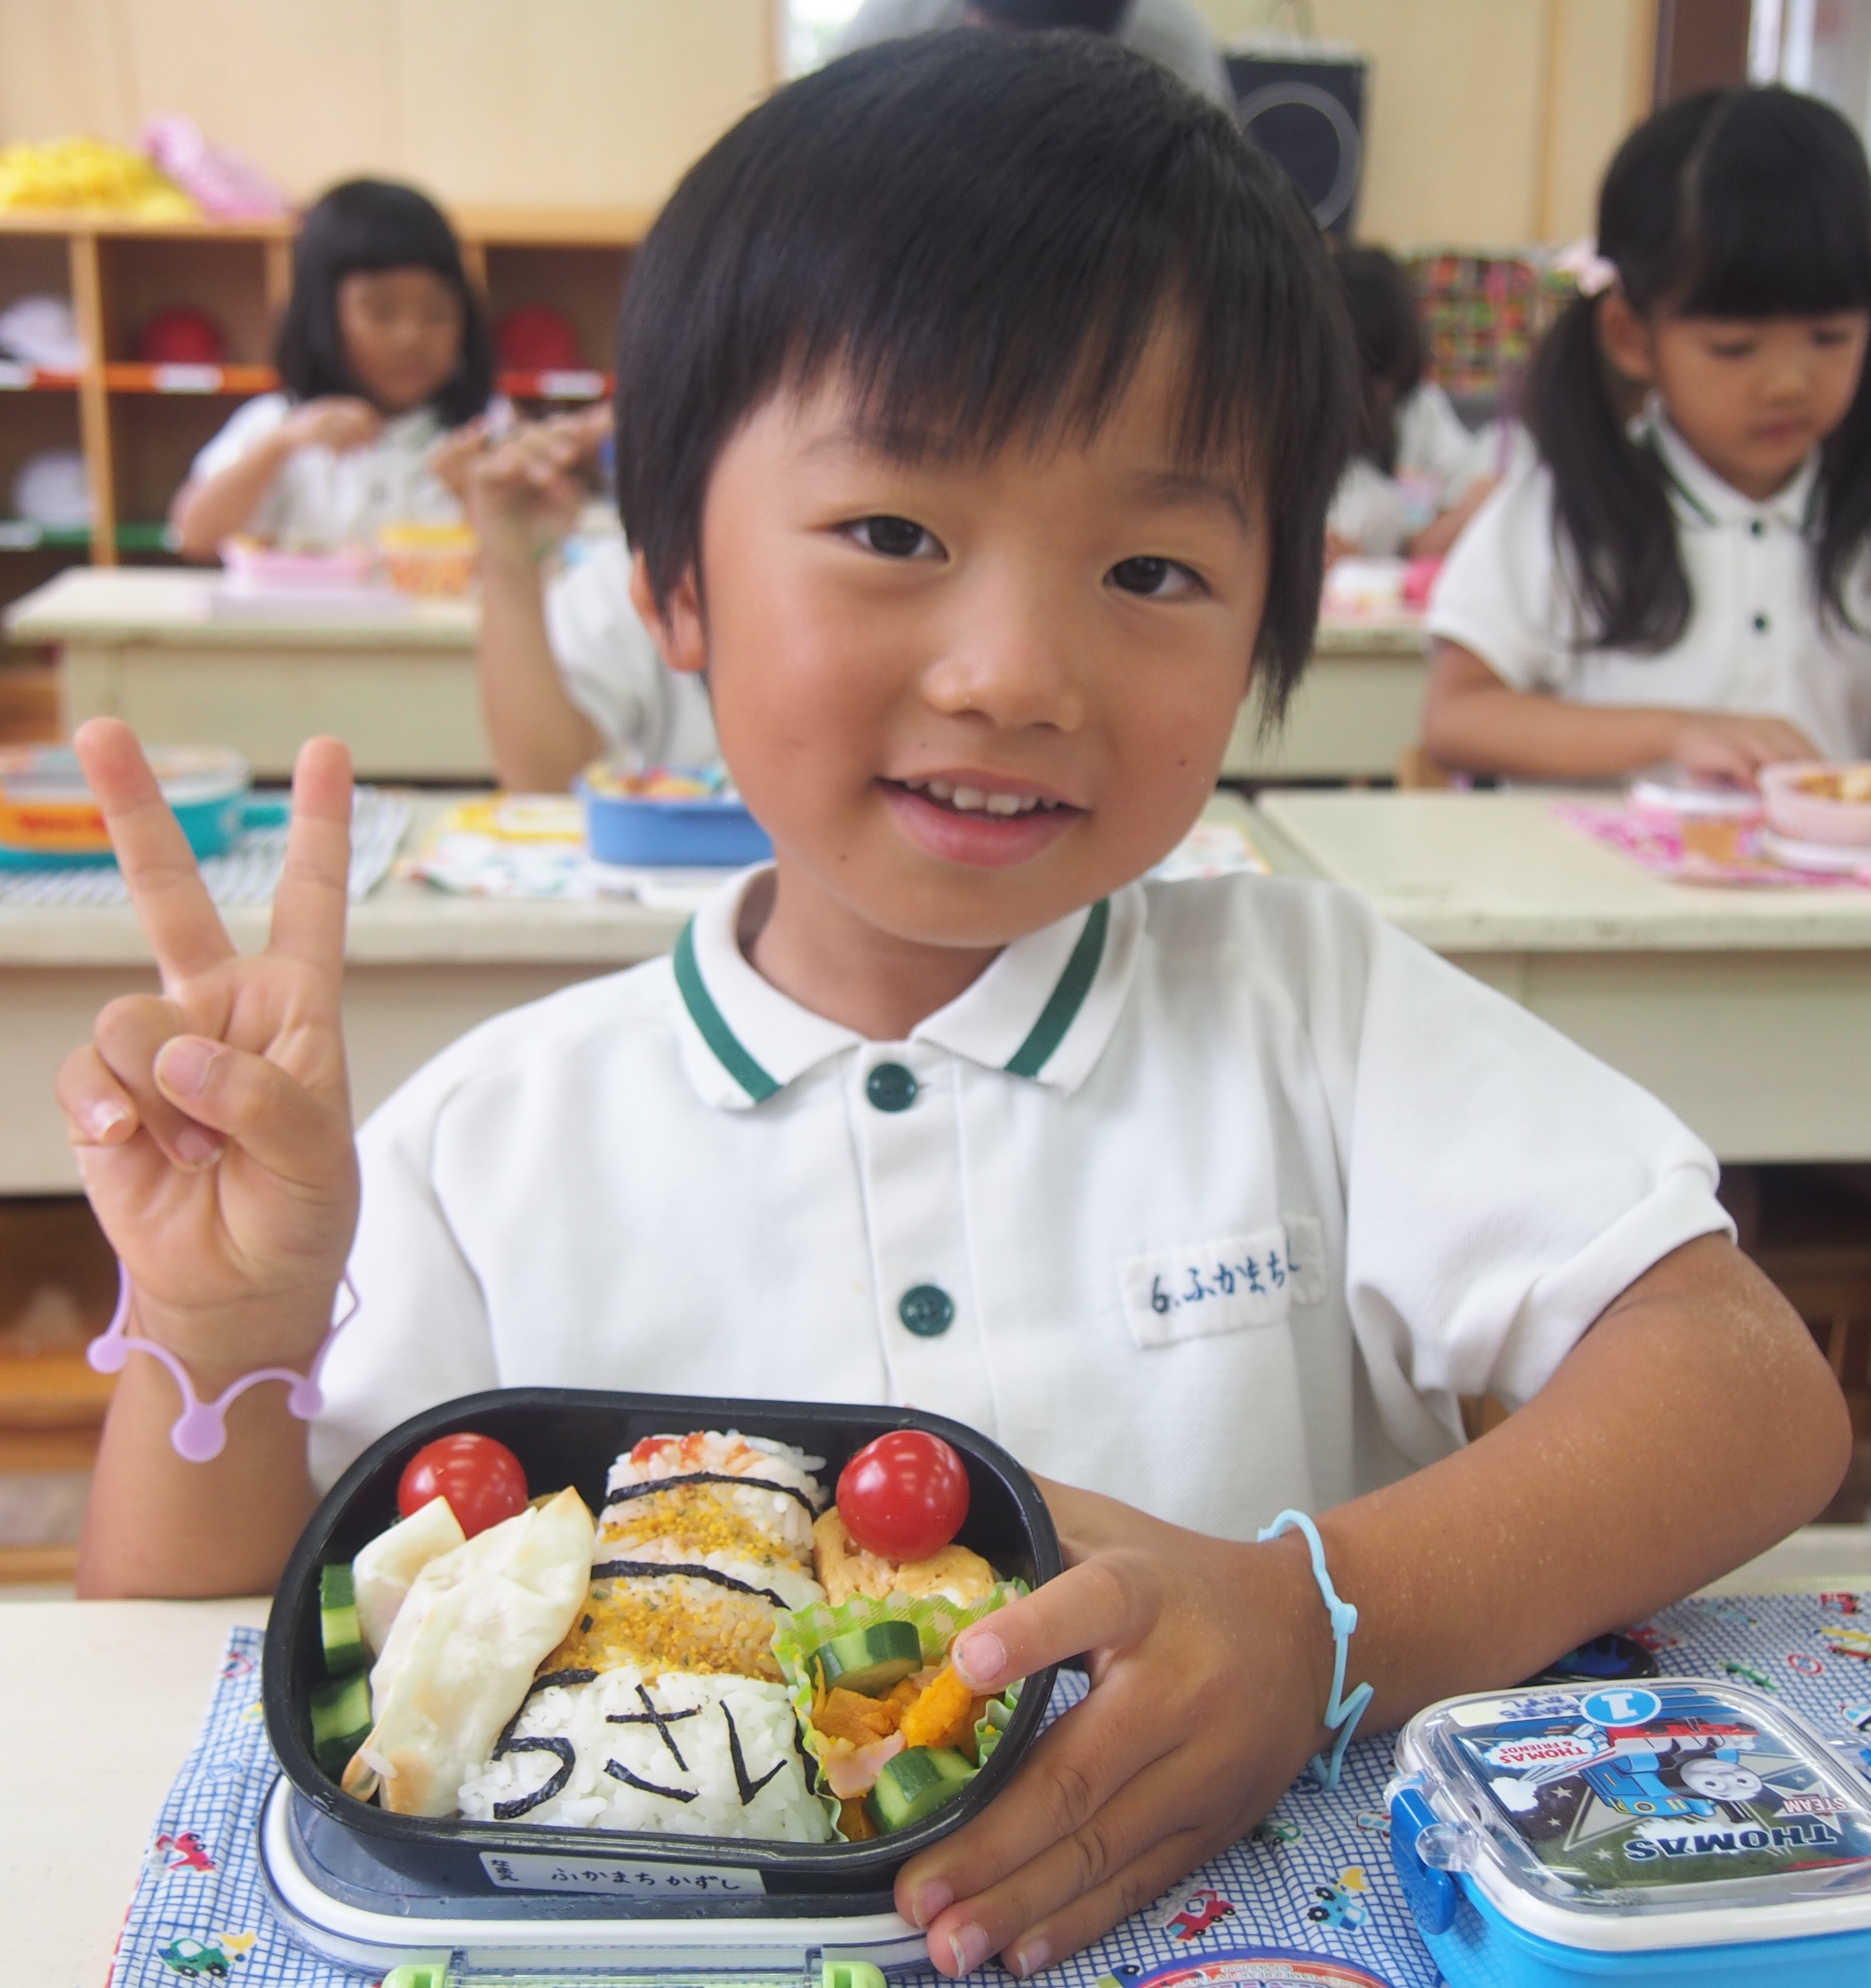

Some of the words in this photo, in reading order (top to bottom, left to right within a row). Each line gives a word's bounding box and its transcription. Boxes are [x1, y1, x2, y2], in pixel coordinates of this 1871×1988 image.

[1600, 1693, 1639, 1720] 1
[1499, 1741, 1560, 1755] FRIENDS
[1562, 1741, 1573, 1749] &
[1498, 1746, 1589, 1764] THOMAS
[1783, 1796, 1848, 1814] STEAM
[1623, 1824, 1839, 1861] THOMAS
[551, 1868, 655, 1885] ふかまち
[666, 1875, 740, 1890] かずし
